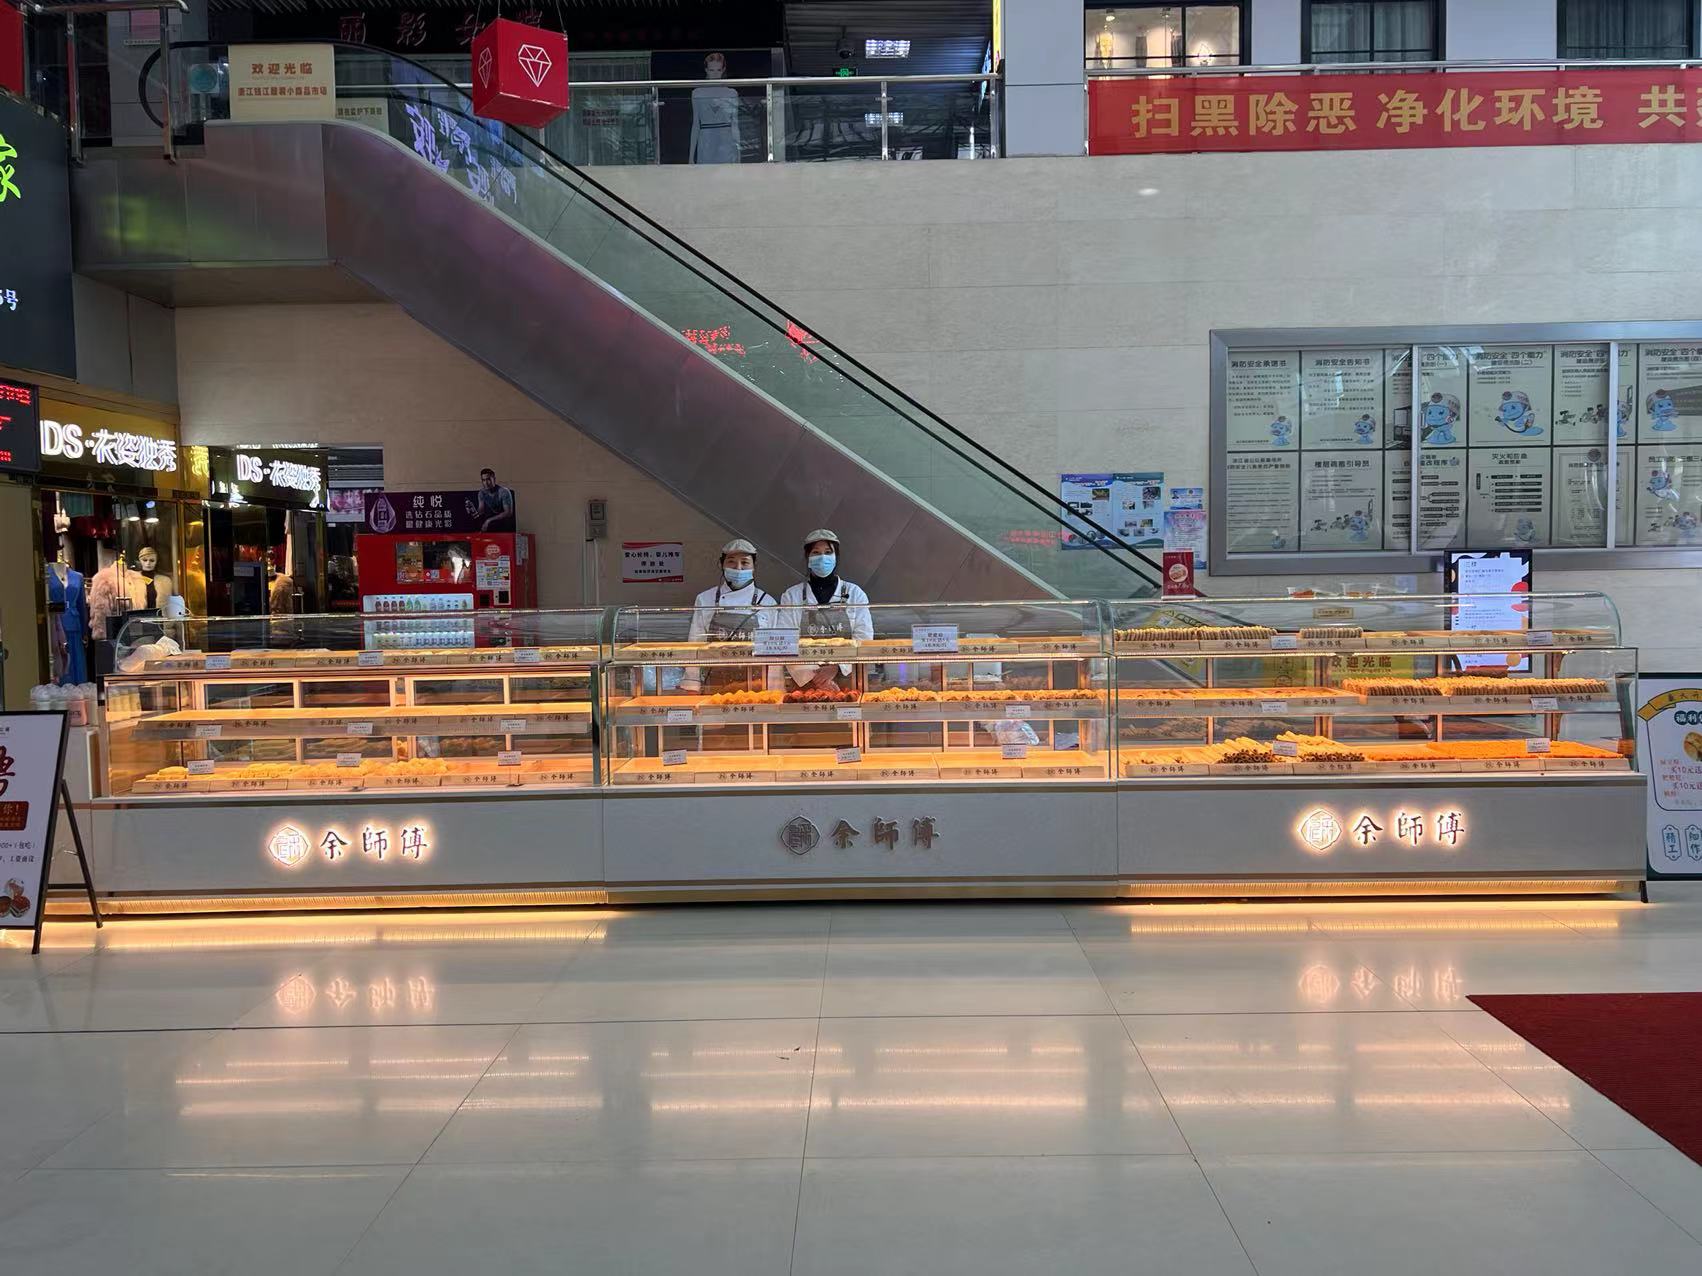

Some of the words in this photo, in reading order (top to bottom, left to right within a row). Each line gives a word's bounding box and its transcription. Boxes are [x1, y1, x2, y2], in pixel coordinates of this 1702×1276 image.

[251, 63, 313, 75] 欢迎光临
[1131, 92, 1357, 138] 扫黑除恶
[1376, 85, 1604, 134] 净化环境
[1638, 83, 1702, 129] 共
[412, 495, 443, 508] 纯悦
[1675, 713, 1702, 723] 福利
[320, 826, 428, 859] 余師傅
[831, 816, 940, 850] 余師傅
[1353, 812, 1465, 845] 余師傅
